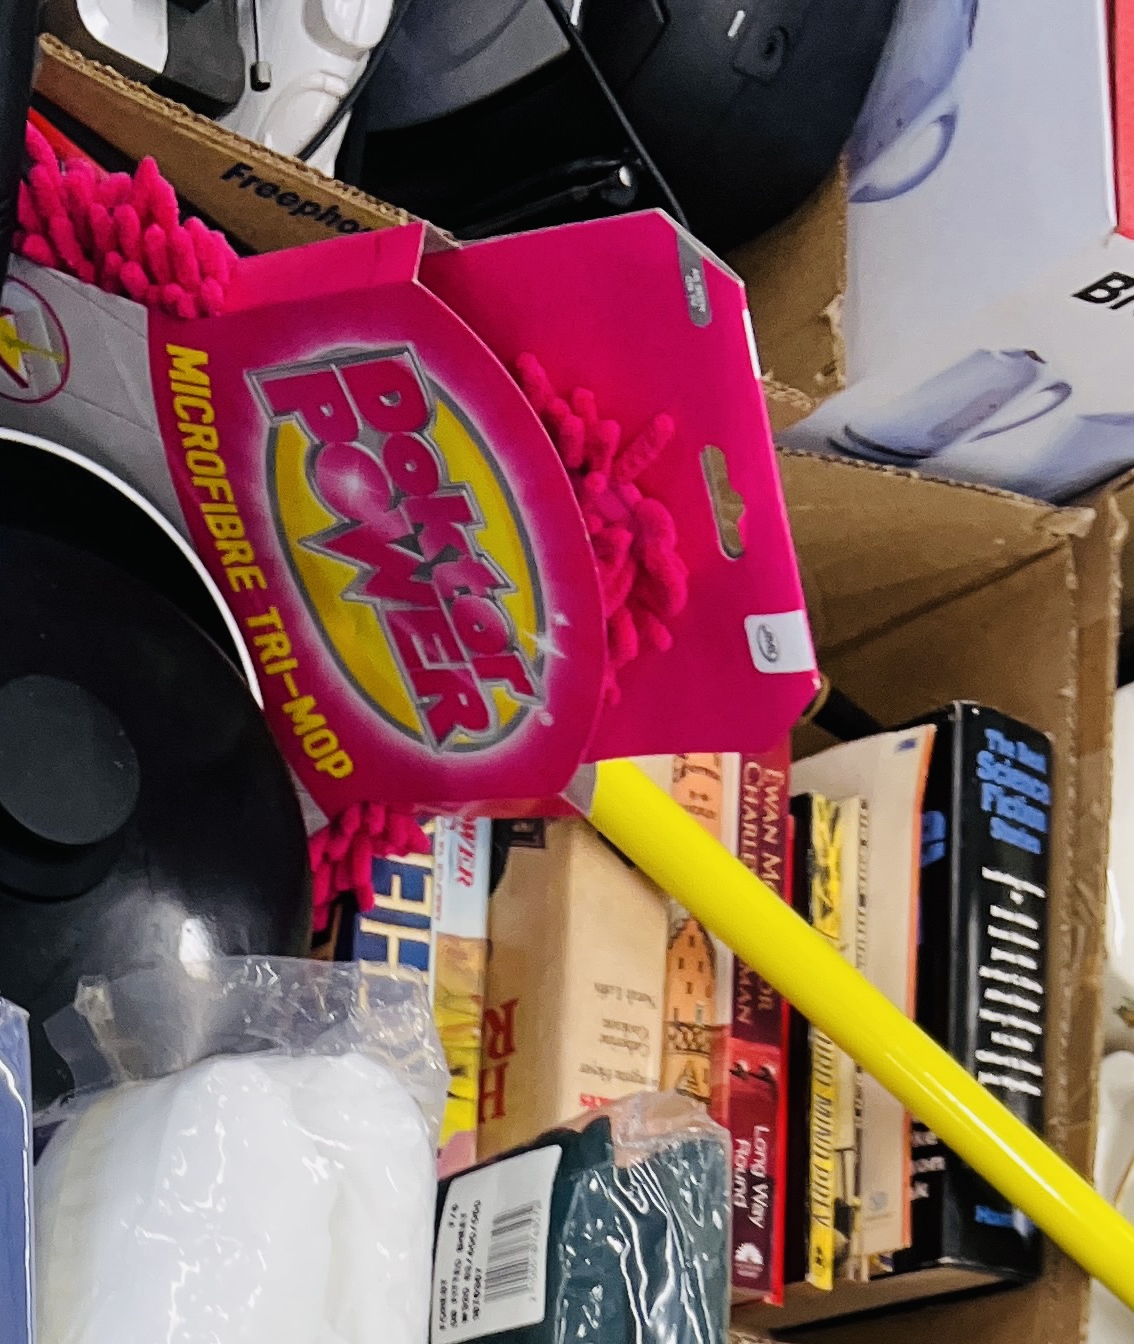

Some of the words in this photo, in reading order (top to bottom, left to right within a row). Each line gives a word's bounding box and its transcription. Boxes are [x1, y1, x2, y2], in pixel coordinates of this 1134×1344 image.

[166, 344, 266, 592] MICROFIBRE
[246, 606, 354, 780] TRI-MOP
[247, 364, 500, 753] POWER
[760, 769, 786, 846] EWAN
[750, 1125, 770, 1178] Long
[748, 1184, 770, 1229] Way
